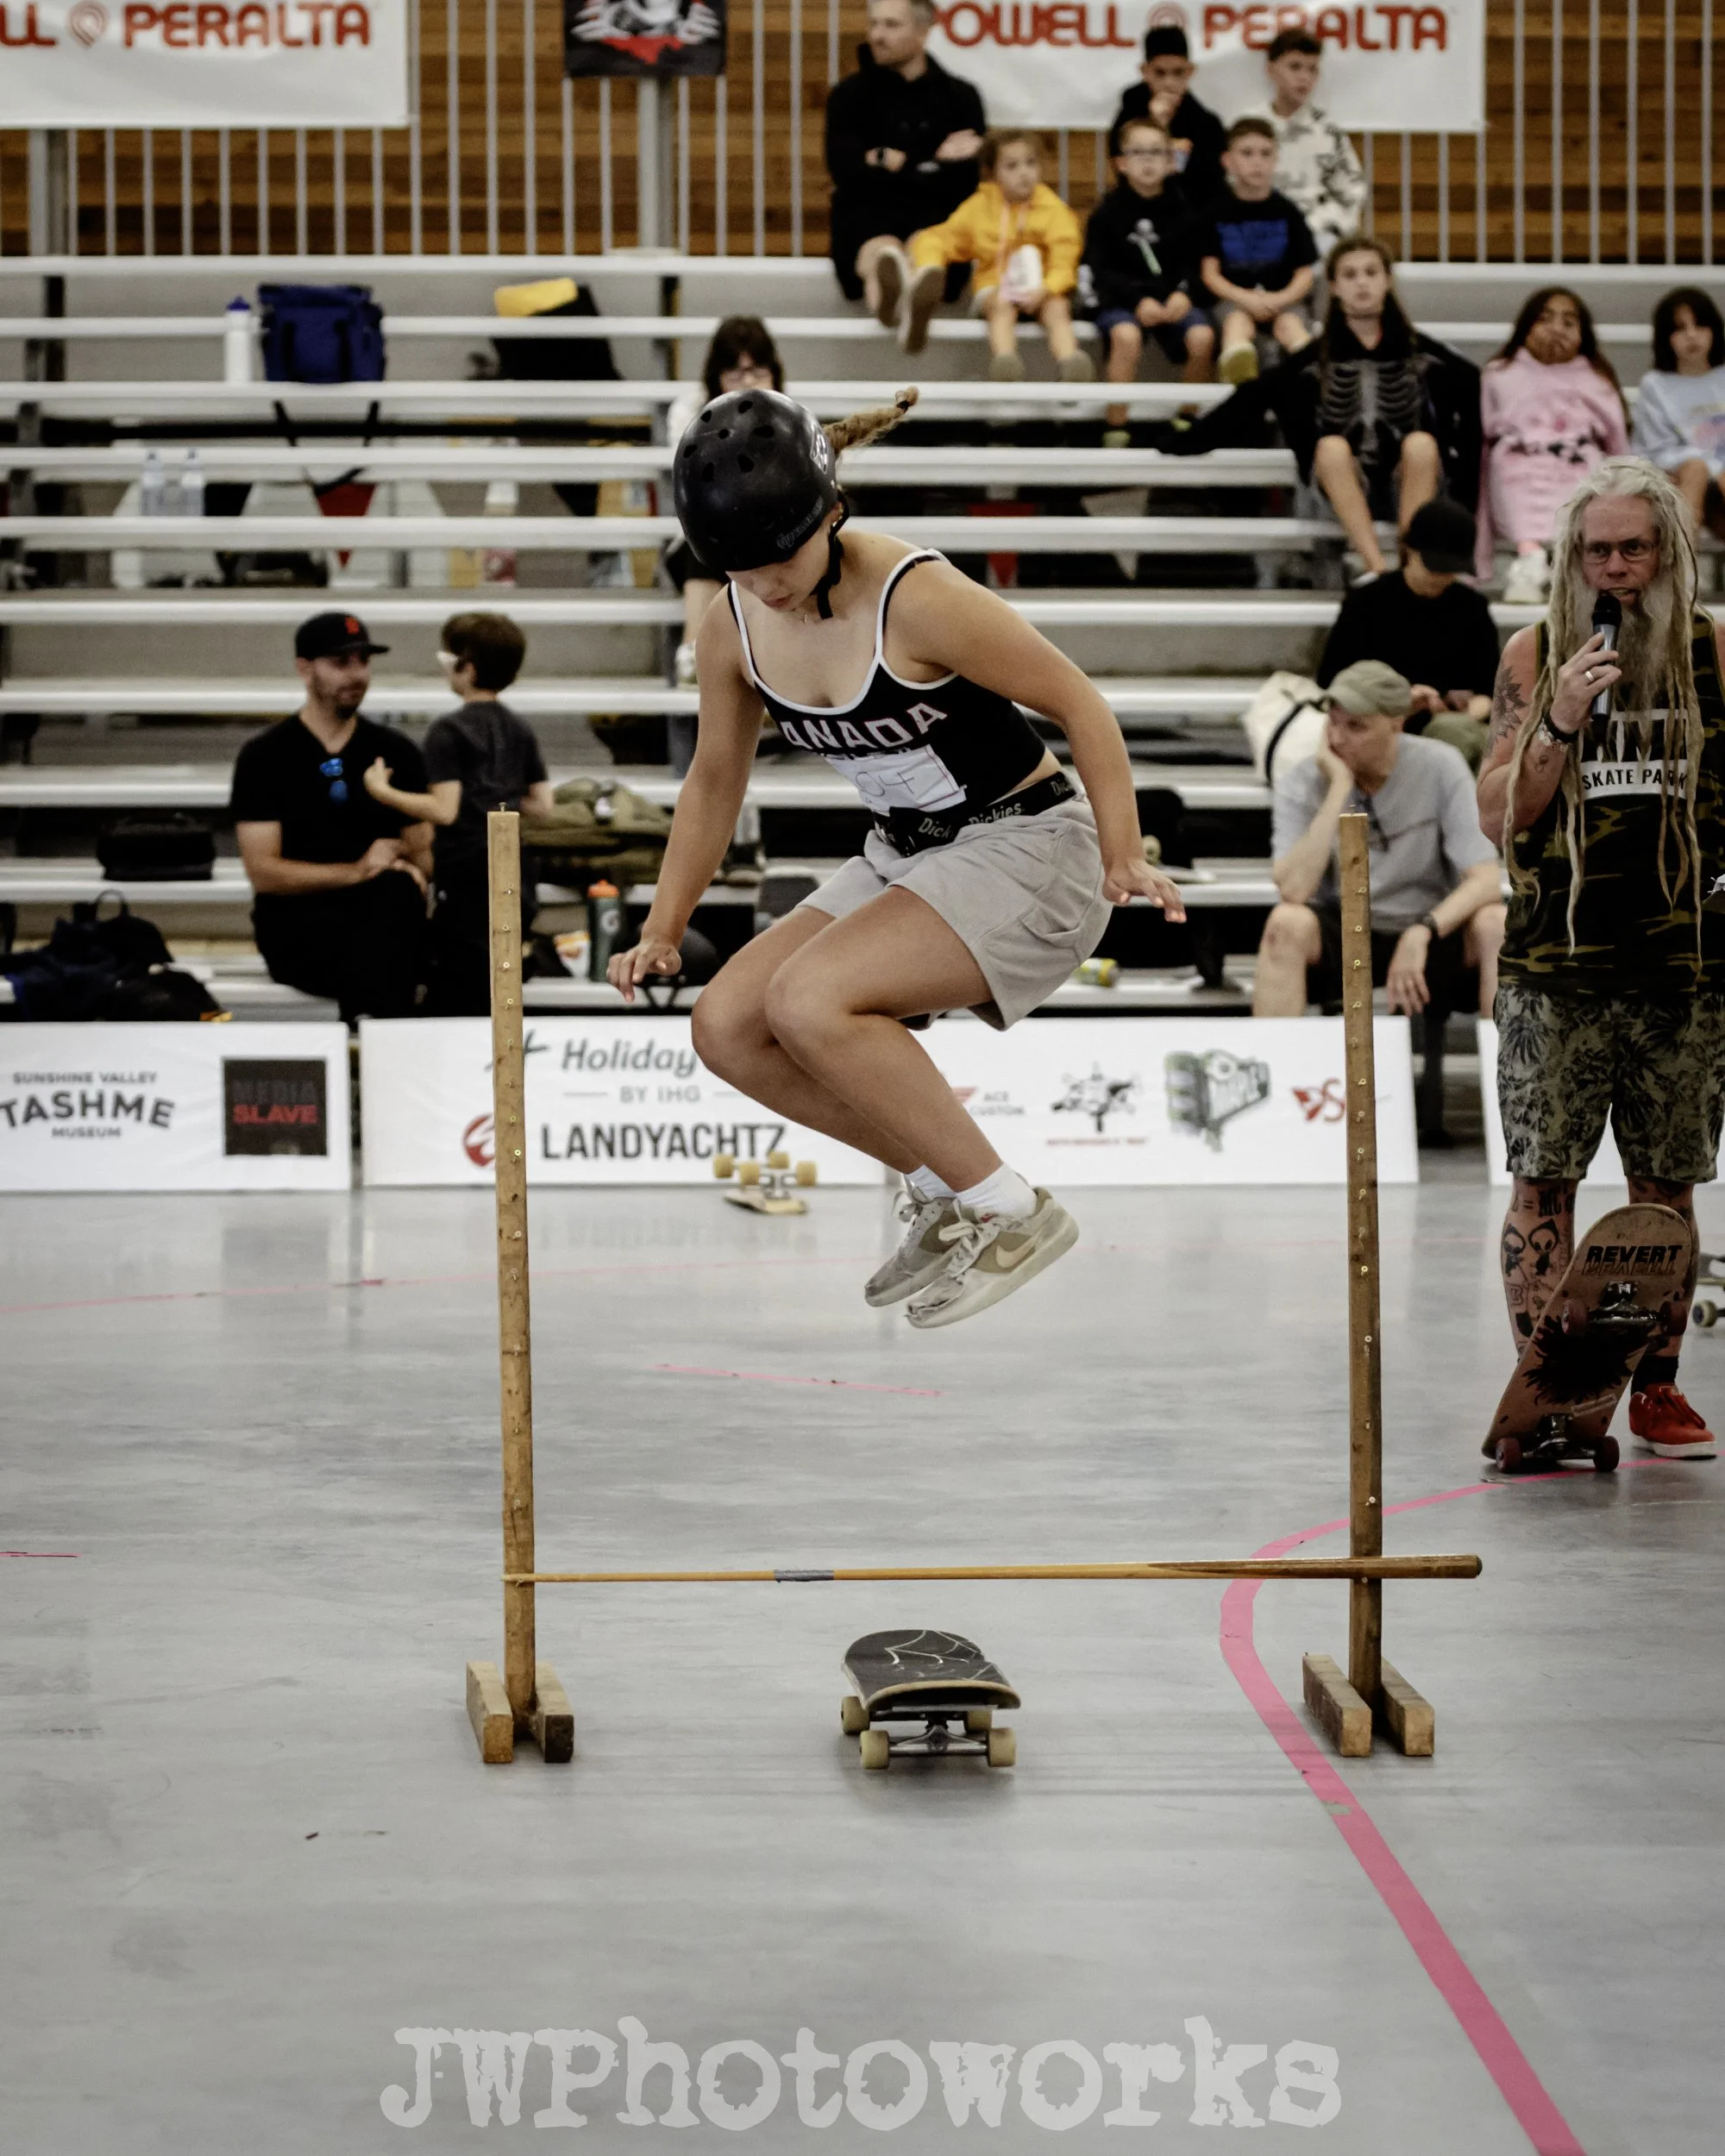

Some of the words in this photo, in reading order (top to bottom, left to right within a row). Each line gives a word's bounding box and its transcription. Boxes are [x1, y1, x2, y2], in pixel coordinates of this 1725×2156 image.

[124, 3, 370, 47] PERALTA
[932, 2, 1136, 47] OWELL
[1202, 3, 1447, 51] PERALTA
[1582, 768, 1634, 791] SKATE
[561, 1037, 697, 1078] Holiday
[13, 1071, 93, 1084] SUNSHINE
[99, 1071, 157, 1084] VALLEY
[619, 1086, 647, 1103] BY
[657, 1085, 701, 1103] IHG
[0, 1089, 175, 1128] TASHME
[233, 1104, 318, 1125] SLAVE
[52, 1126, 122, 1138] MUSEUM
[541, 1123, 786, 1158] LANDYACHTZ
[1585, 1244, 1683, 1263] REVERT
